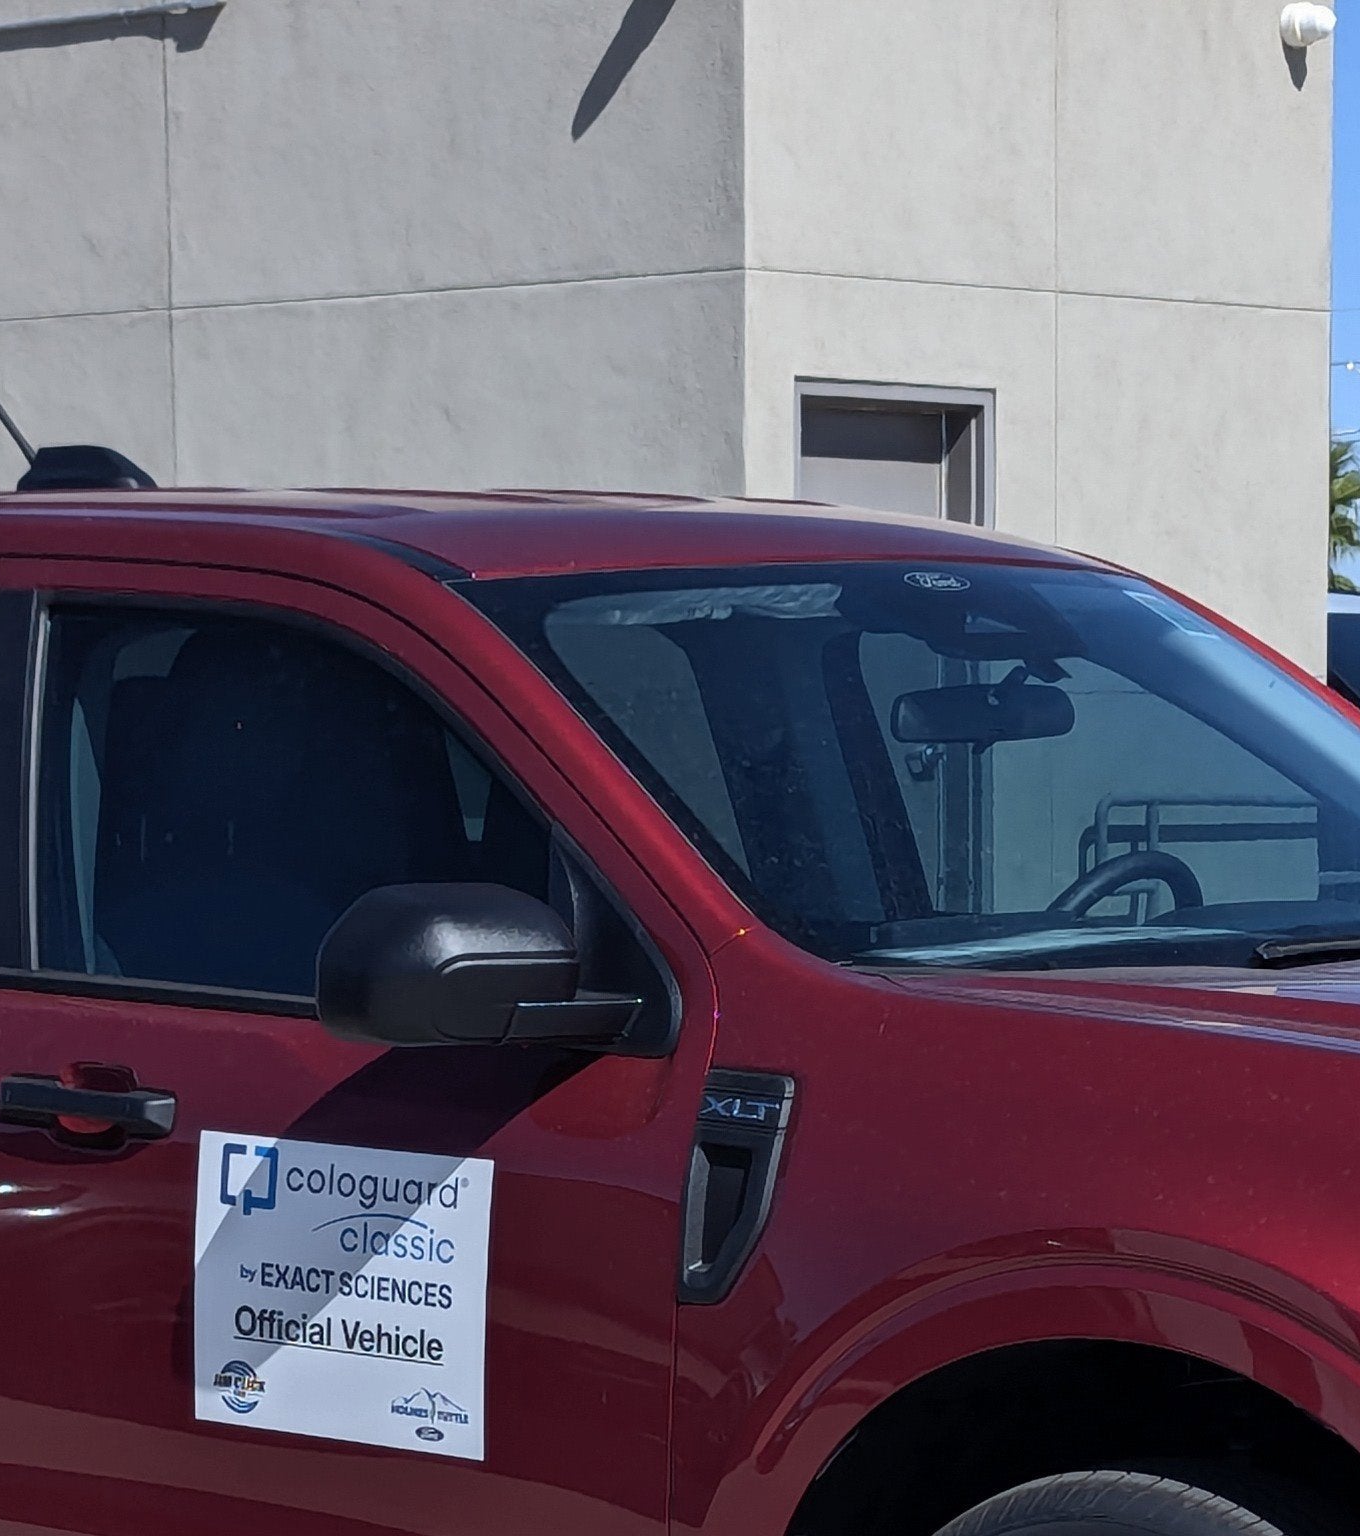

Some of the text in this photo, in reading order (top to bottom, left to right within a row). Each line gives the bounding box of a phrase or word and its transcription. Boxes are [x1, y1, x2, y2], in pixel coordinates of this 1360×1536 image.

[700, 1096, 780, 1121] XLT
[340, 1221, 455, 1264] classic
[240, 1262, 453, 1310] by EXACT SCIENCES
[234, 1304, 444, 1361] Official Vehicle
